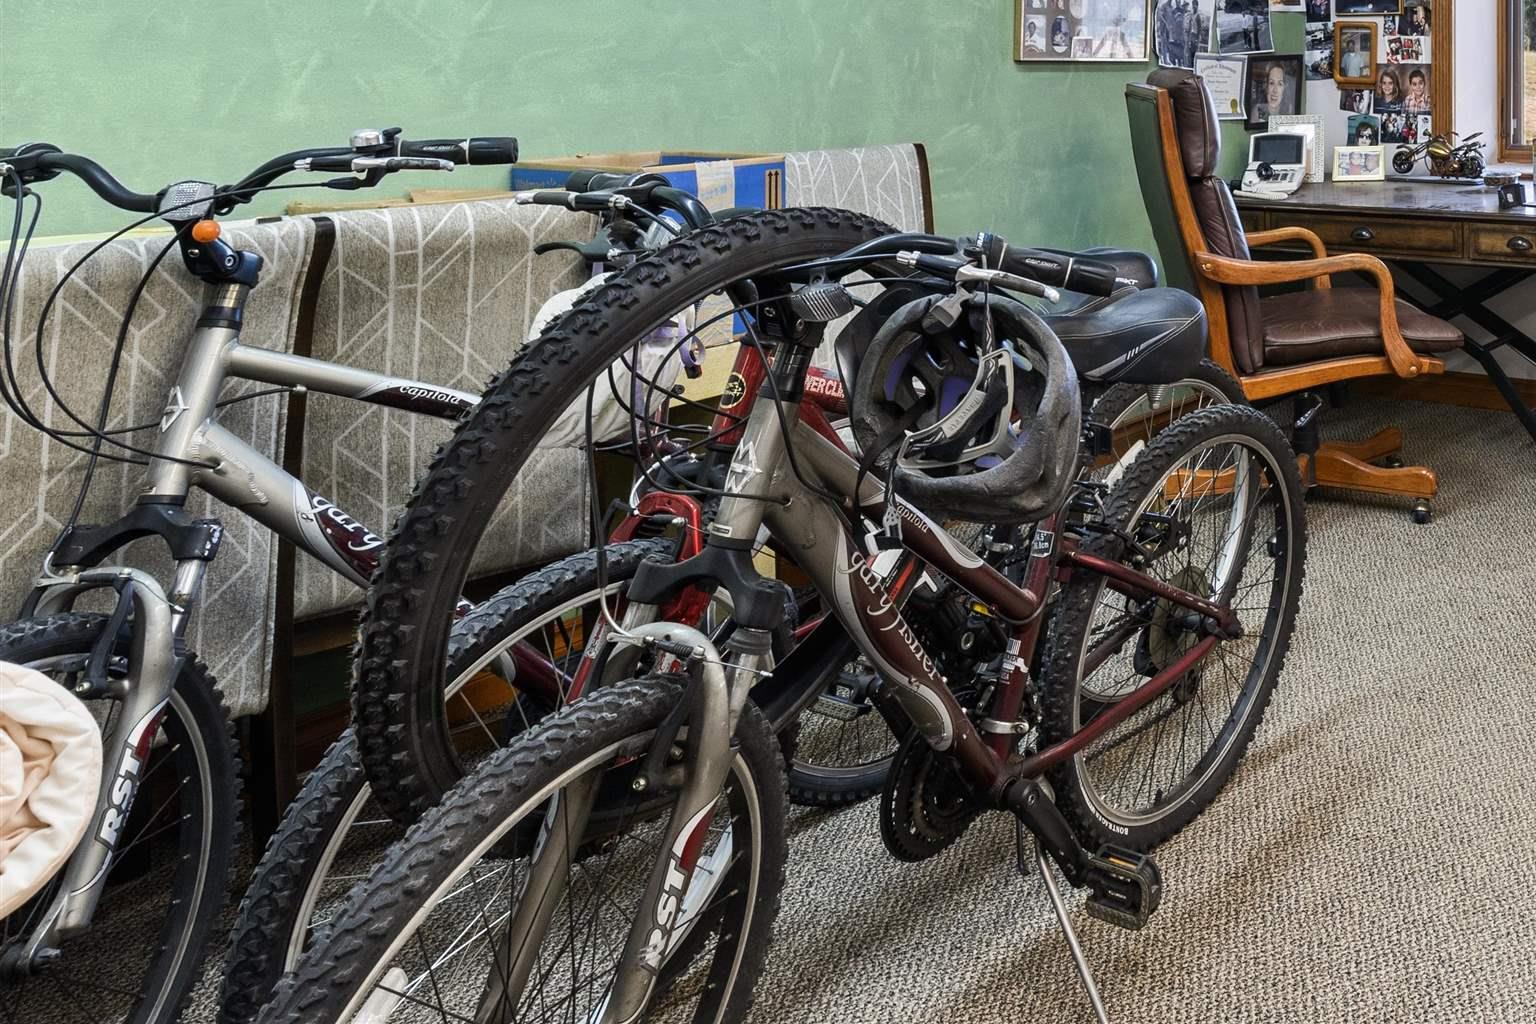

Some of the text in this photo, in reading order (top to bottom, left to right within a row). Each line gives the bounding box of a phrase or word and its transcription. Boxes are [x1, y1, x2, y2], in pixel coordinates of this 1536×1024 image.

[896, 502, 930, 534] apitola
[99, 747, 141, 846] RST
[641, 858, 686, 969] RST
